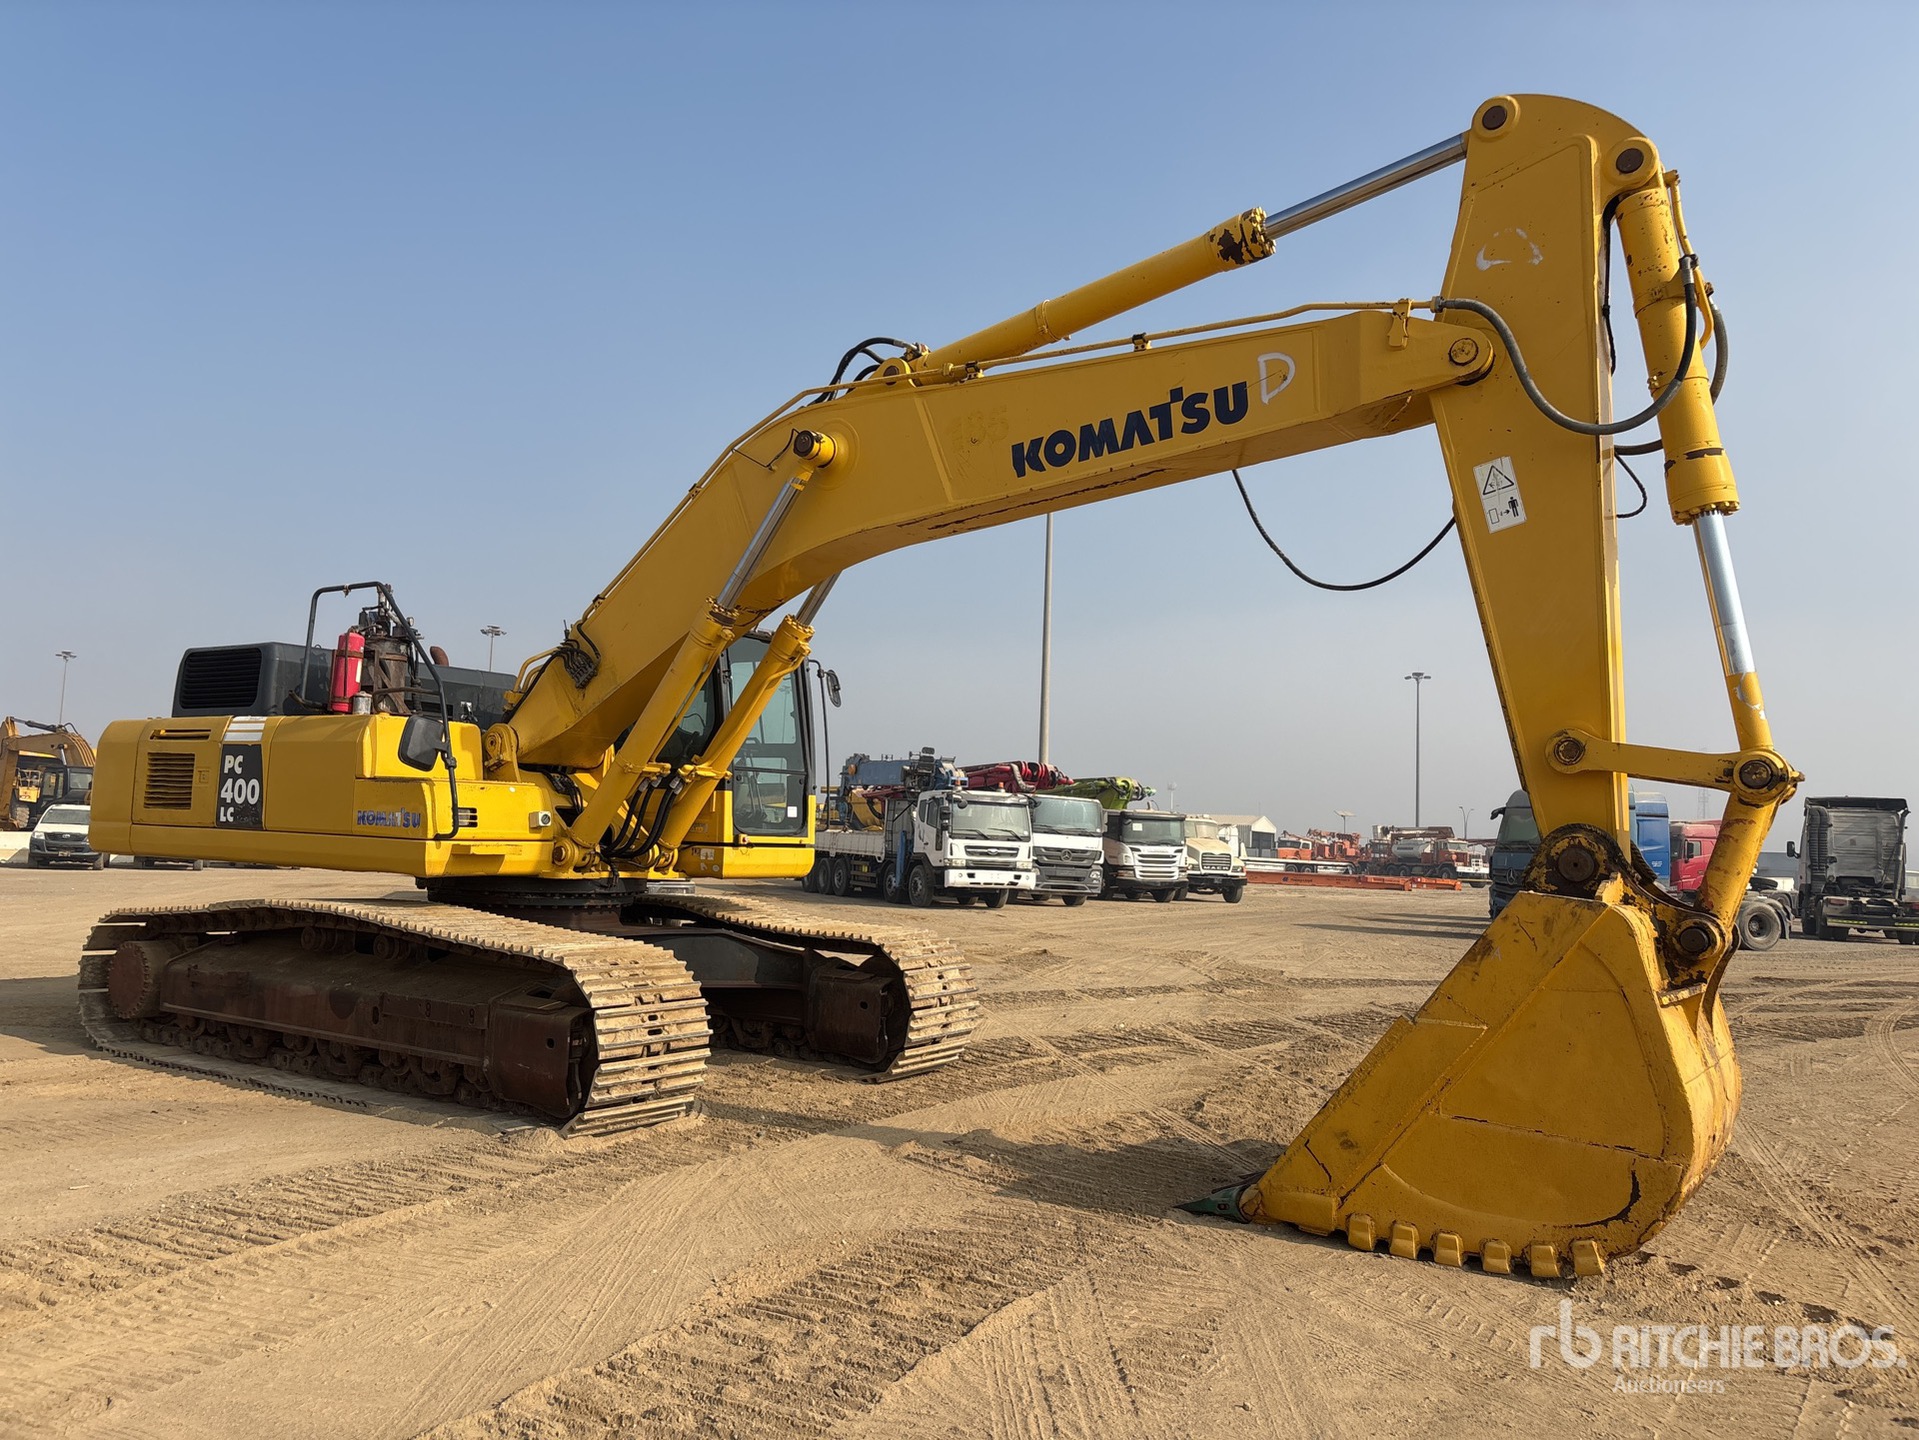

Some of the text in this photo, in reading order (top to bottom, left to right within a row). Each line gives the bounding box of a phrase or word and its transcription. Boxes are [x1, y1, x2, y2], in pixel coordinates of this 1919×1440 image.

[1011, 381, 1249, 478] KOMATSU
[223, 754, 244, 775] PC
[220, 777, 260, 805] 400
[219, 806, 235, 823] LC
[357, 807, 421, 829] KOMATSU
